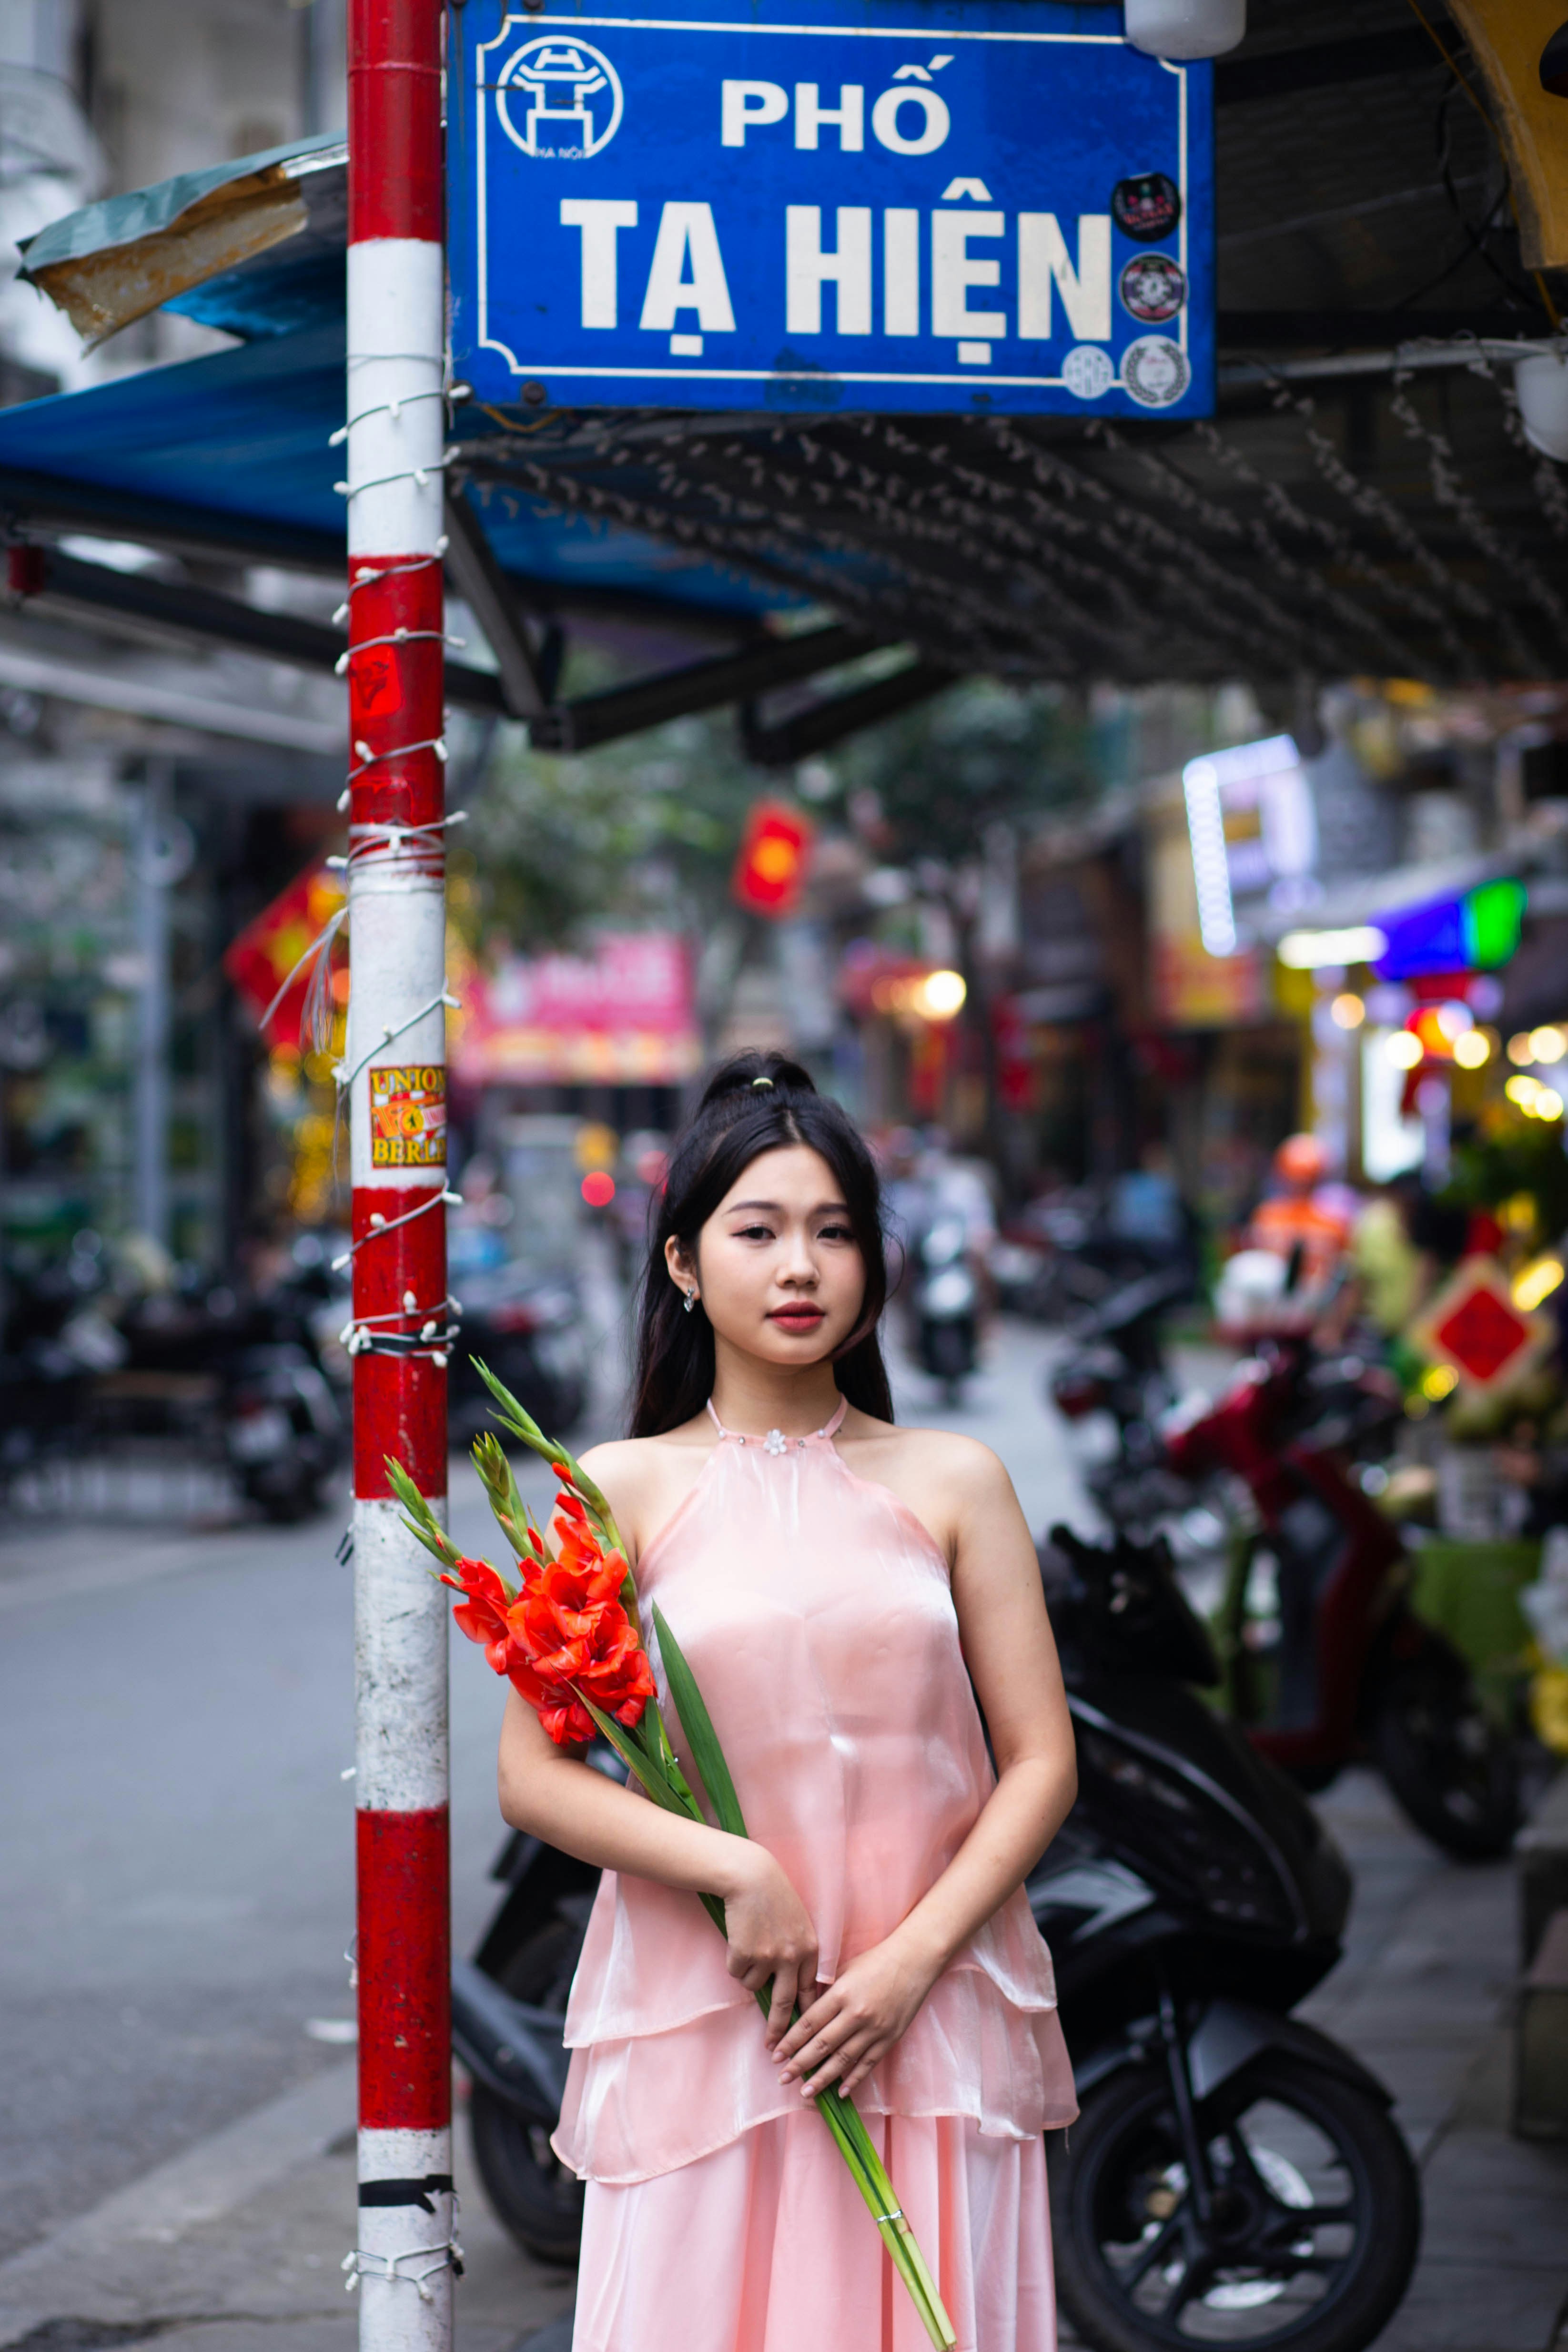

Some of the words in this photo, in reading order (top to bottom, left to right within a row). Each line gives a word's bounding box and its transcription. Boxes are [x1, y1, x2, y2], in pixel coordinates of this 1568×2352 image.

[722, 55, 954, 155] PHỐ
[560, 199, 736, 356] TẠ
[786, 177, 1112, 365] HIỆN
